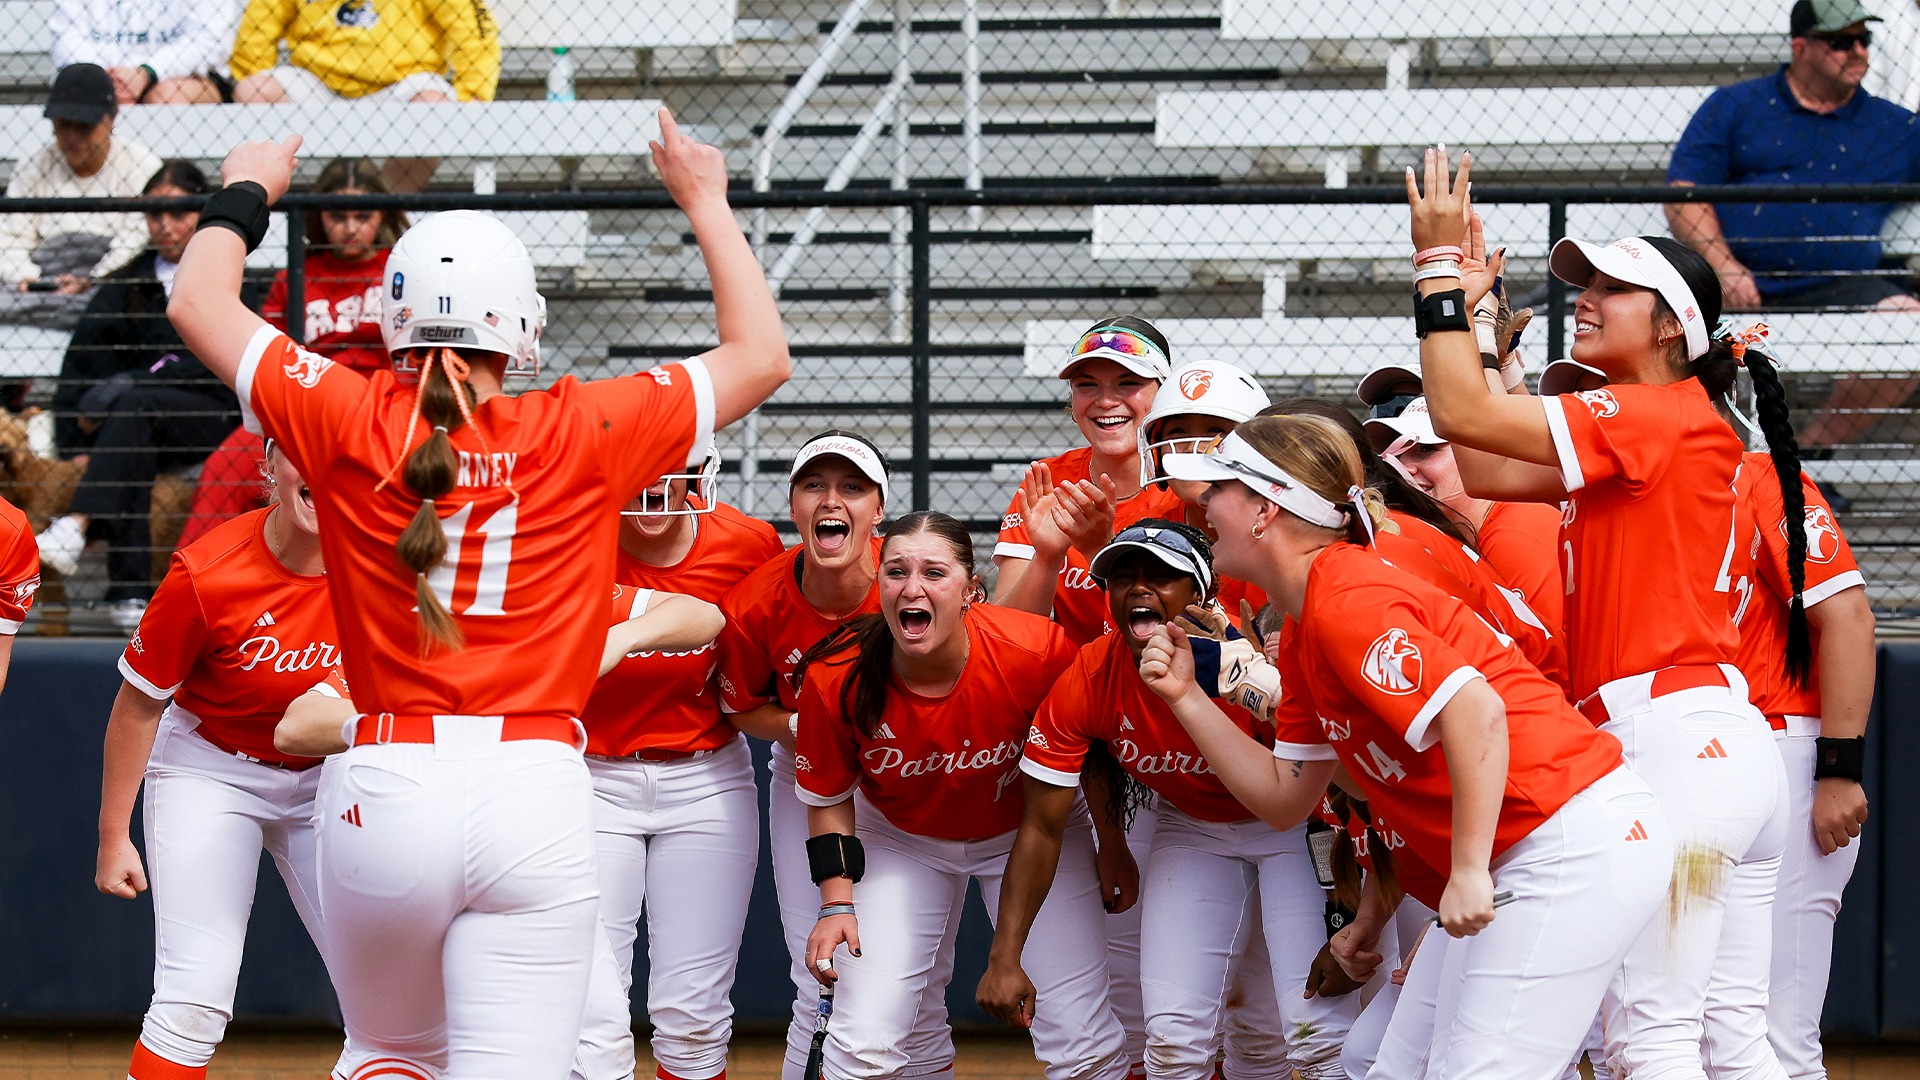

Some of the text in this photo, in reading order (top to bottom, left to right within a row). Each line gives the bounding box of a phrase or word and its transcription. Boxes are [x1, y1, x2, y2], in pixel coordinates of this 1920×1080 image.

[438, 296, 451, 314] 11
[419, 326, 465, 340] schutt
[804, 441, 868, 460] Patriots
[411, 498, 520, 616] 11
[864, 738, 1024, 778] Patriots
[1353, 740, 1408, 787] 14
